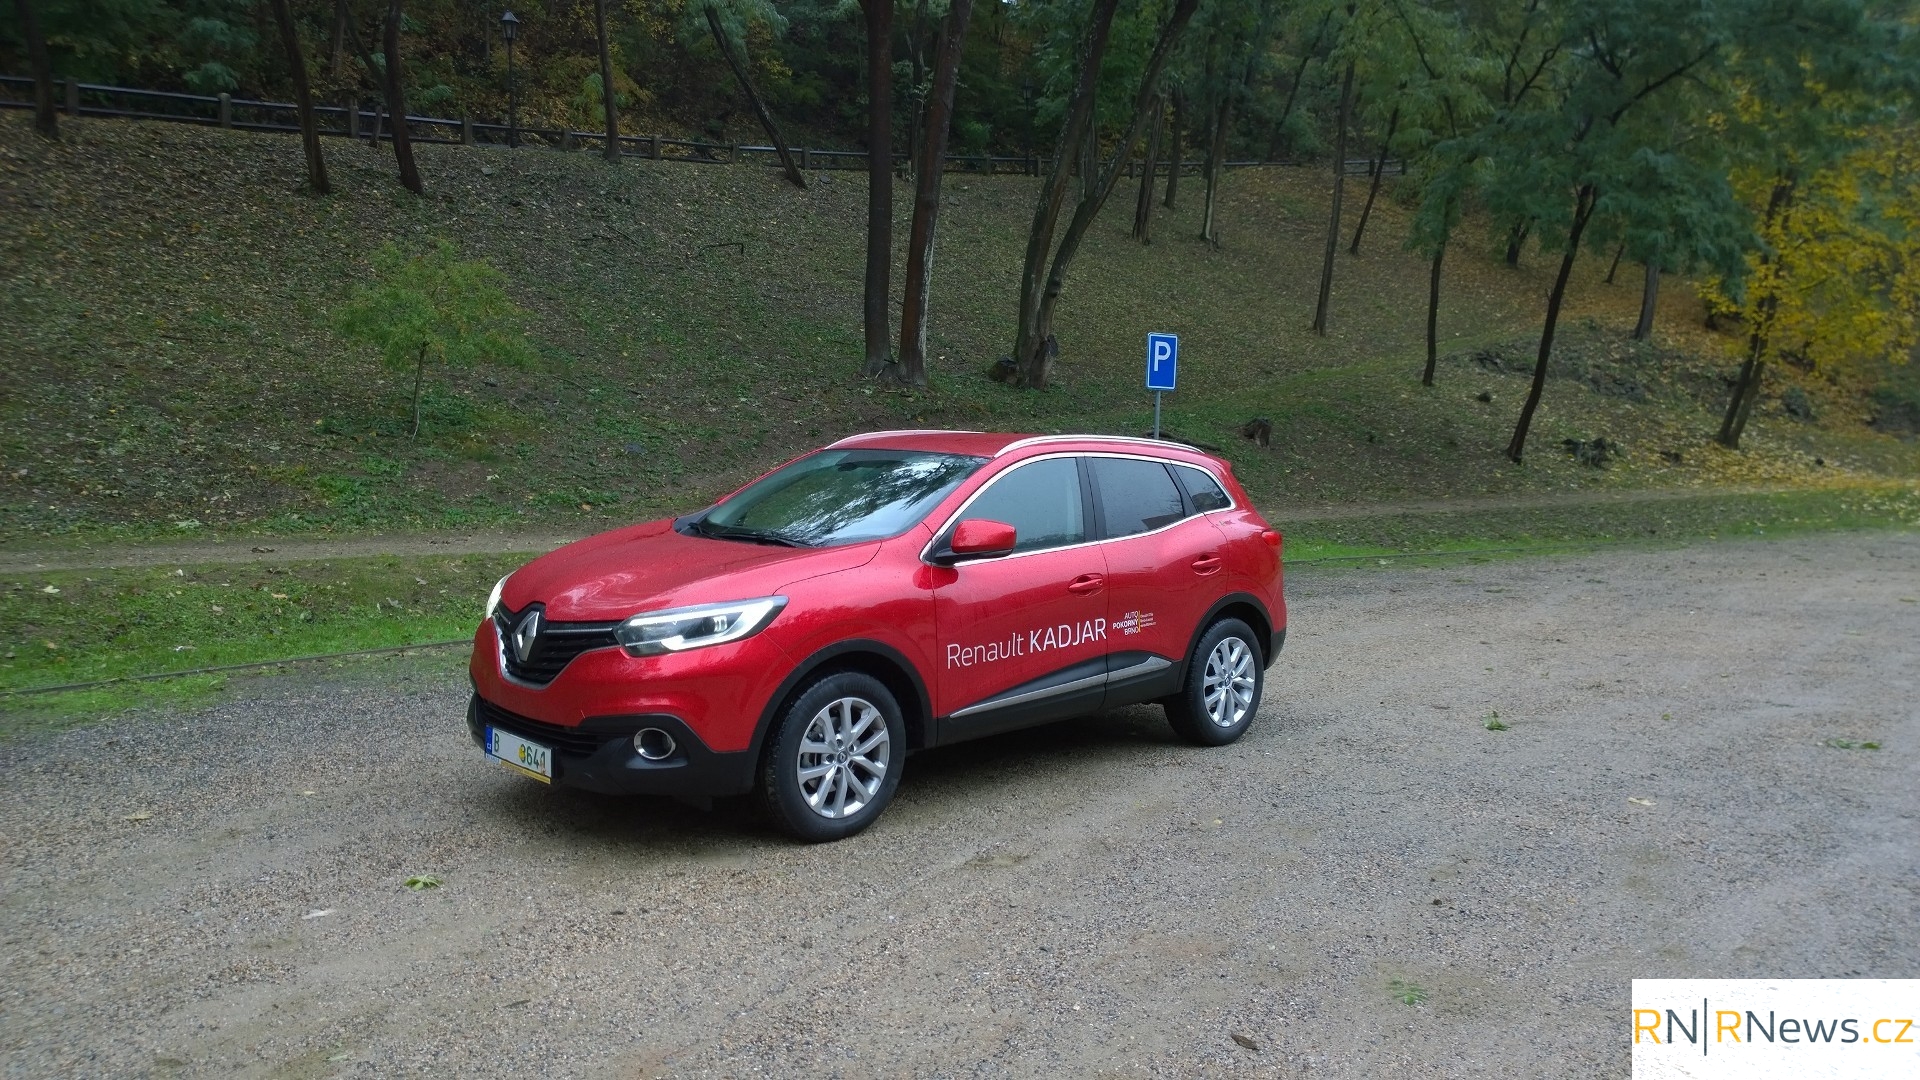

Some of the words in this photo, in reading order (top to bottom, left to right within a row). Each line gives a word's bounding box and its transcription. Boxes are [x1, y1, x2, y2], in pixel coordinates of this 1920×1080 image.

[1154, 341, 1171, 371] P
[1124, 611, 1138, 619] AUTO
[1124, 626, 1138, 635] BRNO
[947, 632, 1024, 669] Renault
[1030, 618, 1107, 653] KADJAR
[494, 732, 500, 752] B
